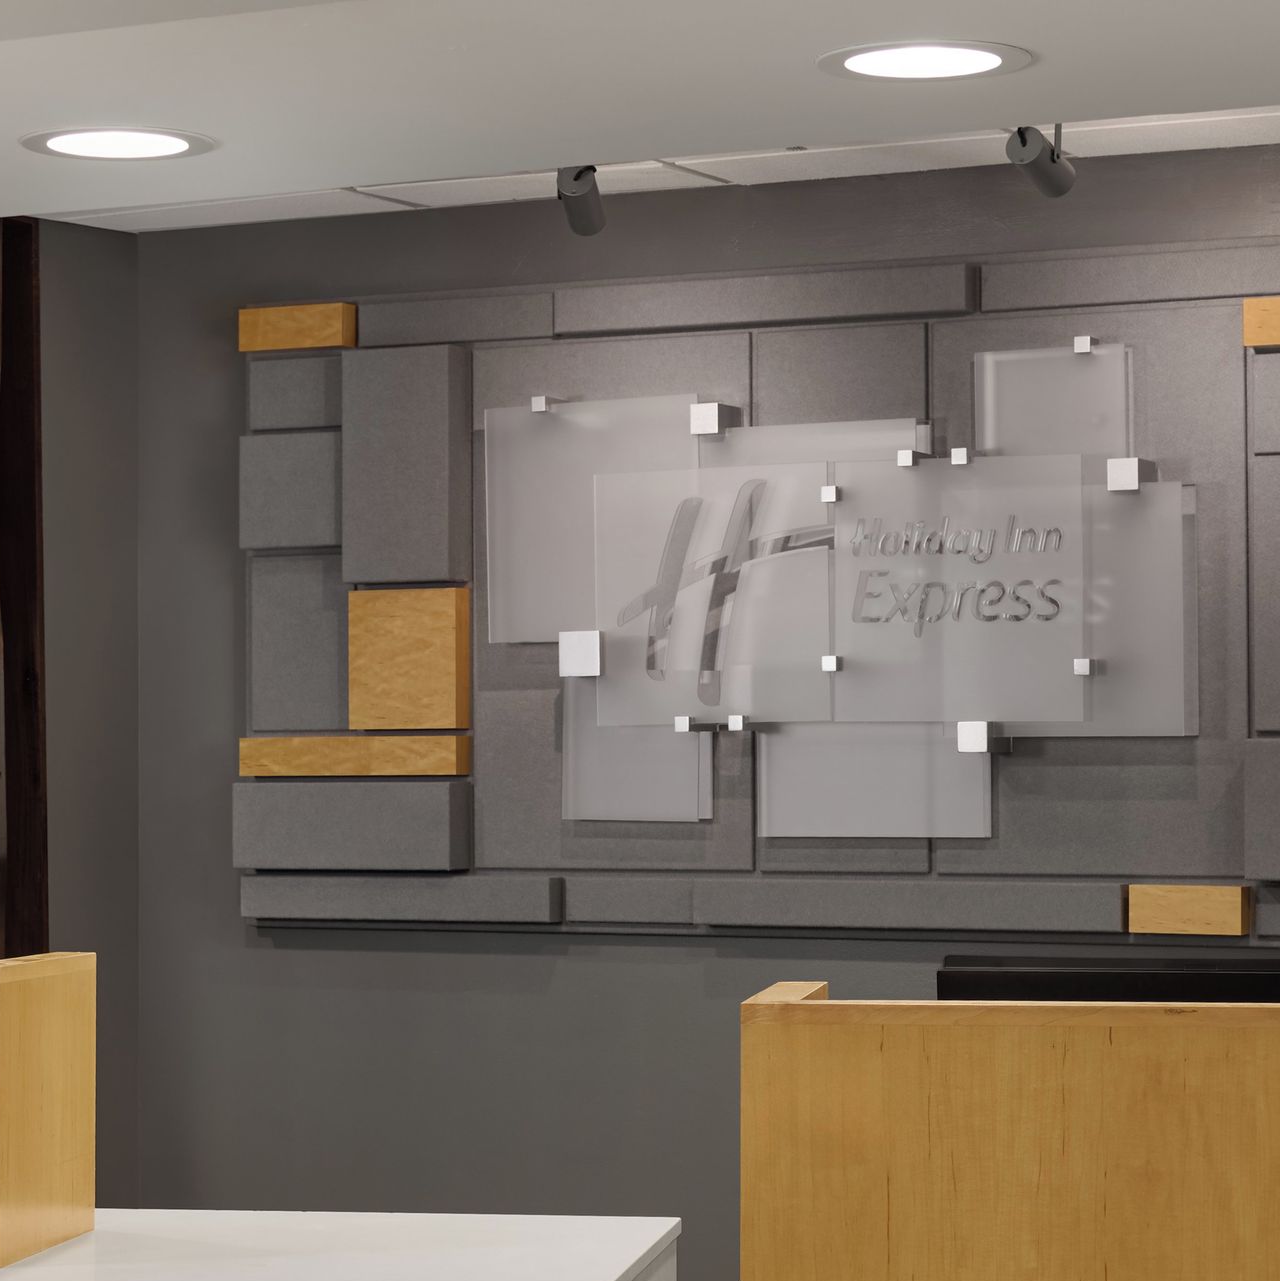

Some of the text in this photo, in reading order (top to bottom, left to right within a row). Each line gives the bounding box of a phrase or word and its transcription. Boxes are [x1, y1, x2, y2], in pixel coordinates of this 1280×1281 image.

[849, 514, 1062, 564] Holiday Inn
[851, 569, 1063, 638] Express
